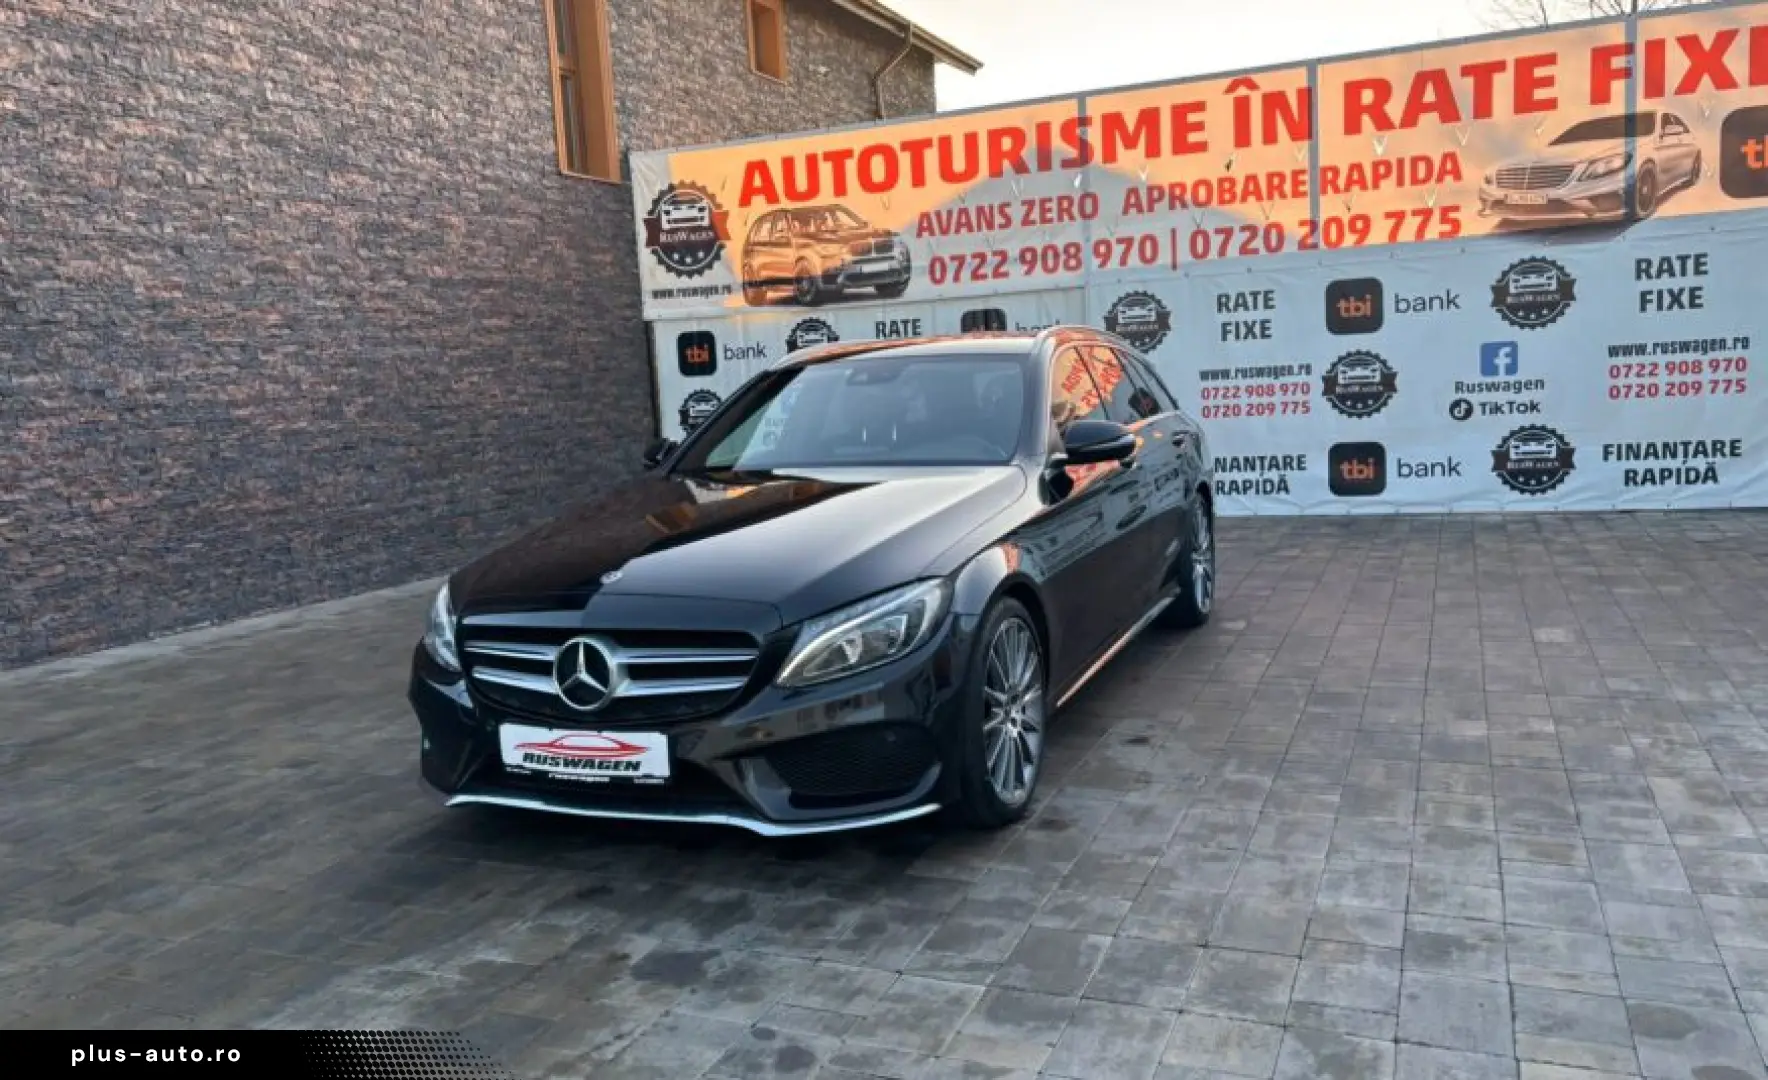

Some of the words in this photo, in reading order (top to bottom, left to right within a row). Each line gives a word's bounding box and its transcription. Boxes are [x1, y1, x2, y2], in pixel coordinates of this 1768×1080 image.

[739, 101, 1207, 207] AUTOTURISME
[1224, 76, 1313, 149] ÎN
[1343, 52, 1559, 136] RATE
[916, 200, 1012, 239] AVANS
[1021, 191, 1099, 228] ZERO
[1122, 171, 1307, 216] APROBARE
[1320, 151, 1463, 195] RAPIDA
[928, 250, 1010, 286] 0722
[1019, 240, 1083, 276] 908
[1093, 234, 1160, 269] 970
[1189, 221, 1285, 260] 0720
[1297, 213, 1372, 250] 209
[1384, 204, 1462, 243] 775
[1634, 253, 1709, 281] RATE
[1216, 290, 1276, 313] RATE
[1336, 293, 1372, 319] tbi
[1394, 288, 1462, 315] bank
[1639, 286, 1705, 313] FIXE
[875, 319, 922, 339] RATE
[1220, 319, 1272, 342] FIXE
[685, 346, 710, 364] tbi
[723, 342, 768, 361] bank
[1608, 336, 1751, 358] www.ruswagen.ro
[1200, 363, 1313, 382] www.ruswagen.ro
[1608, 363, 1660, 380] 0722
[1664, 360, 1704, 377] 908
[1708, 357, 1747, 374] 970
[1201, 386, 1242, 401] 0722
[1246, 383, 1277, 399] 908
[1279, 382, 1311, 397] 970
[1454, 378, 1545, 397] Ruswagen
[1608, 384, 1660, 400] 0720
[1664, 382, 1703, 398] 209
[1708, 379, 1747, 395] 775
[1201, 405, 1242, 419] 0720
[1246, 403, 1277, 417] 209
[1280, 401, 1312, 416] 775
[1479, 399, 1541, 416] TikTok
[1340, 460, 1374, 480] tbi
[1396, 456, 1462, 478] bank
[1624, 462, 1719, 488] RAPIDĂ
[1216, 474, 1290, 495] RAPIDĂ
[522, 752, 641, 771] RUSWAGEN
